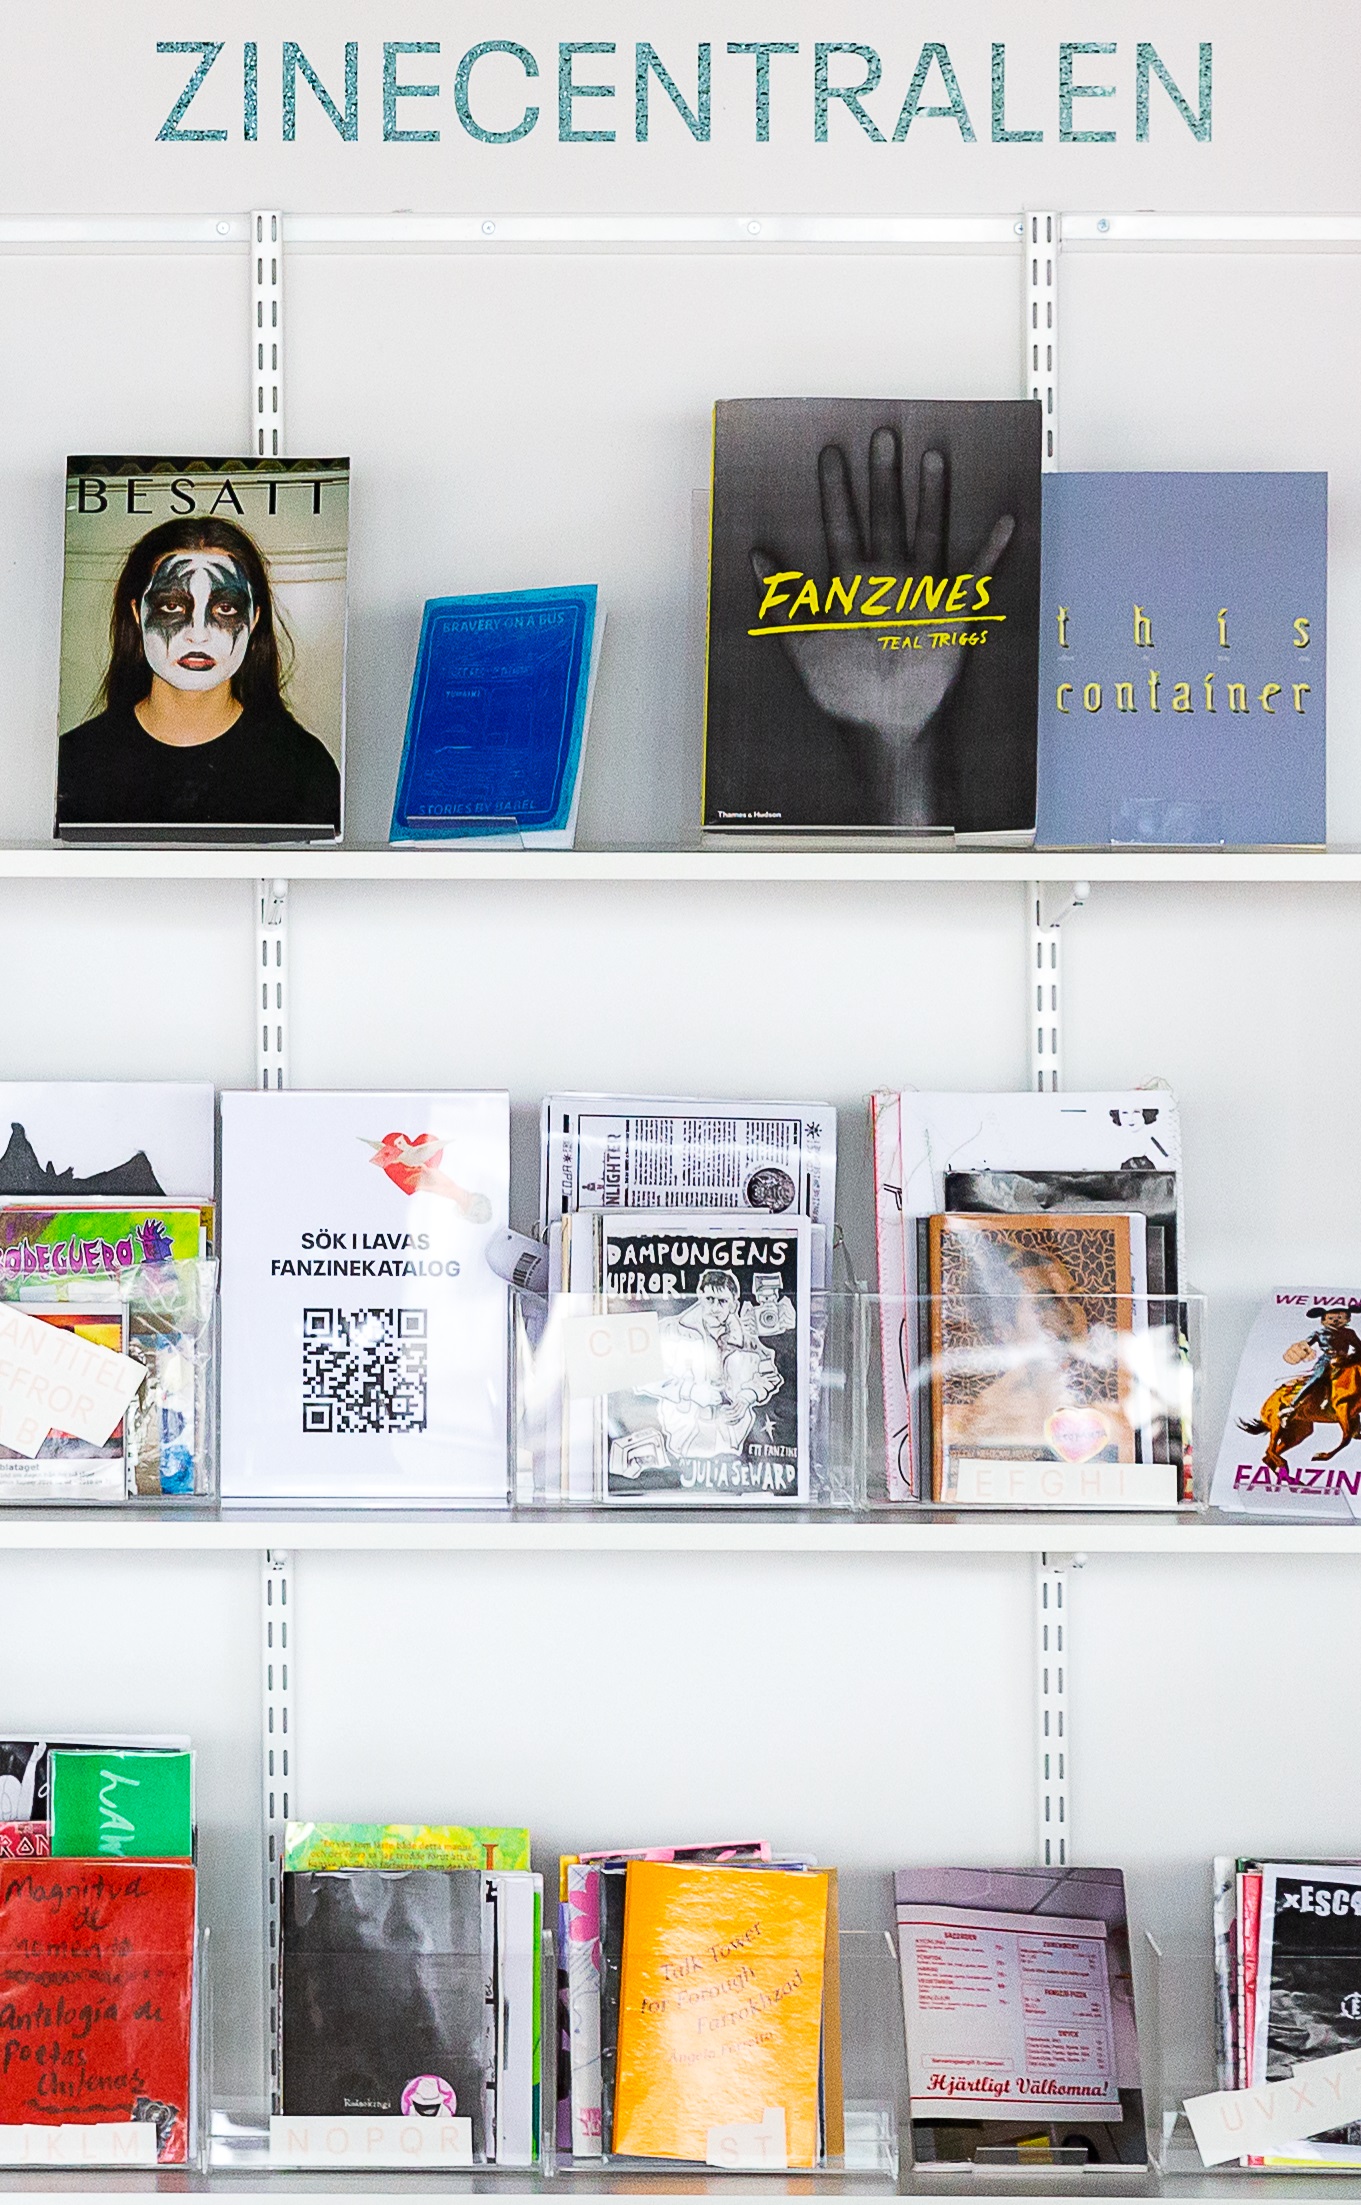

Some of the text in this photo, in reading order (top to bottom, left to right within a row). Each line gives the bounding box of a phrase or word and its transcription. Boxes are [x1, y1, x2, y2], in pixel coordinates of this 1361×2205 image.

[155, 41, 1213, 143] ZINECENTRALEN
[78, 478, 334, 515] BESATT
[758, 571, 993, 620] FANZINES
[443, 611, 565, 633] BRAVERY ON A BUS
[877, 630, 988, 651] TEAL TRIGGS
[1056, 669, 1312, 714] container
[419, 803, 472, 816] STORIES
[475, 802, 491, 813] BY
[717, 810, 747, 819] Thames
[754, 810, 782, 819] Hudson
[301, 1228, 431, 1250] SÖK I LAVAS
[0, 1234, 135, 1283] ODEGUERO
[606, 1240, 790, 1267] DAMPUNGENS
[271, 1259, 461, 1277] FANZINEKATALOG
[607, 1270, 686, 1299] UPPROR!
[1276, 1294, 1309, 1306] WE
[53, 1337, 127, 1395] TITEL
[748, 1445, 798, 1458] ETT FANZINE
[660, 1921, 763, 1982] Talk Tower
[677, 1966, 756, 2008] Forough
[697, 1968, 804, 2035] Farrokhzad
[927, 2073, 1109, 2098] Hjärtligt Välkomna!
